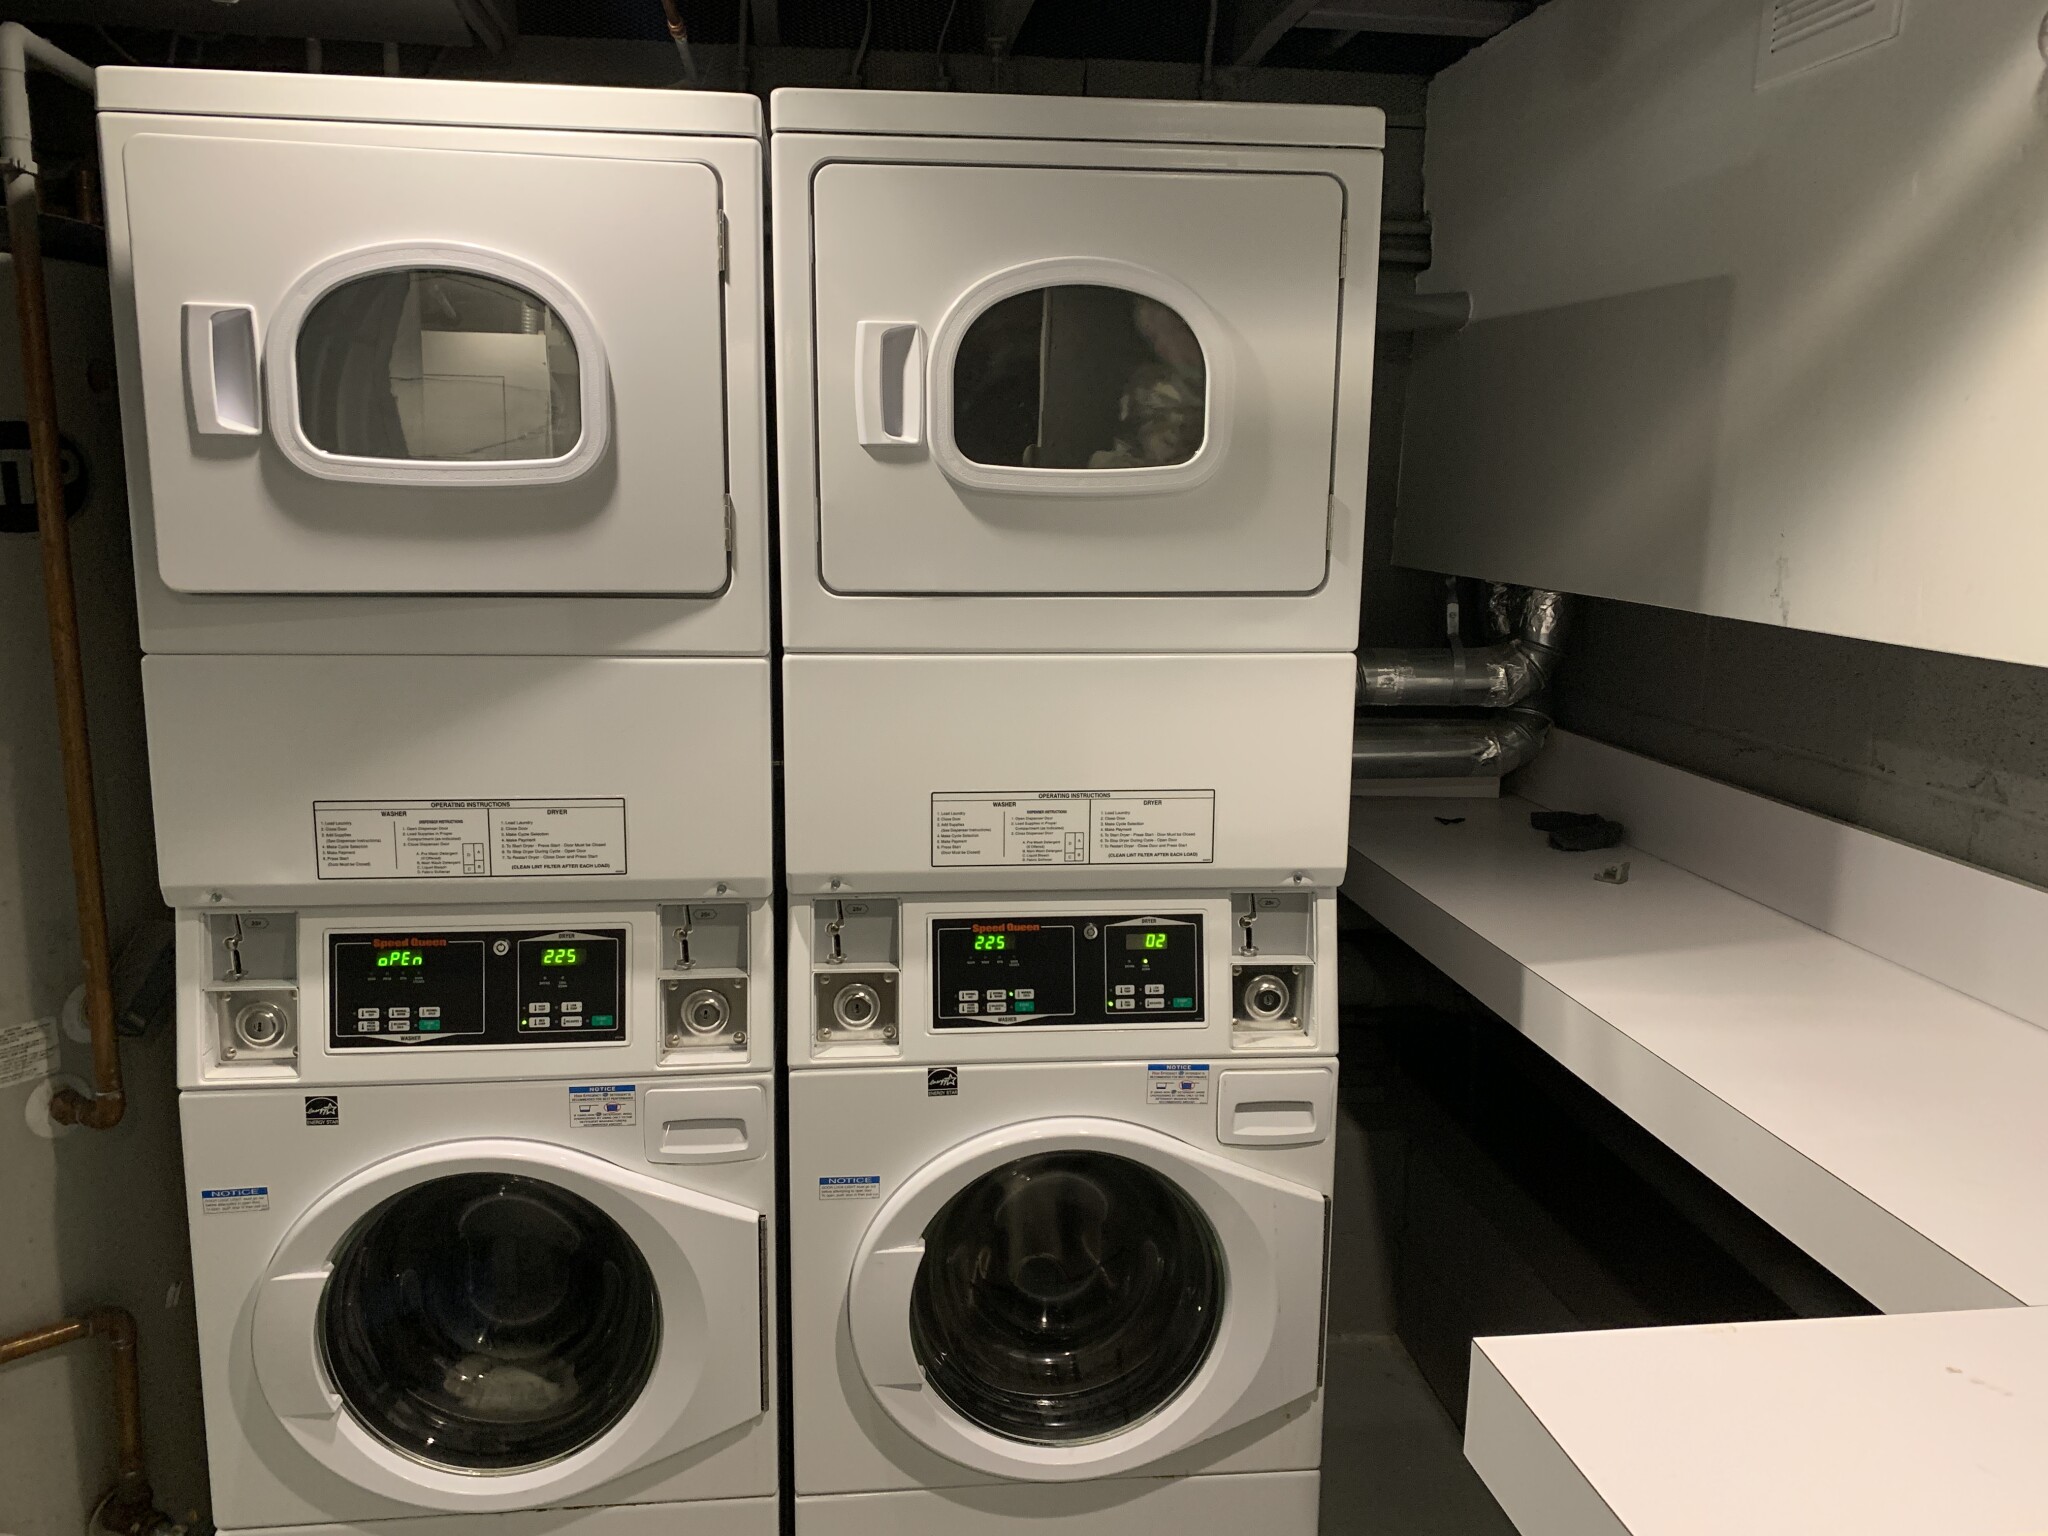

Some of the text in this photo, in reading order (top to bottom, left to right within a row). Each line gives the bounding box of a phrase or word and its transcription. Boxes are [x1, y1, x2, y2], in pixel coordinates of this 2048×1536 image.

[971, 923, 1040, 933] Speed Queen
[373, 937, 446, 948] Speed Queen
[974, 935, 1005, 950] 225
[1145, 933, 1166, 948] 02
[543, 949, 576, 964] 225
[211, 1189, 258, 1197] NOTICE
